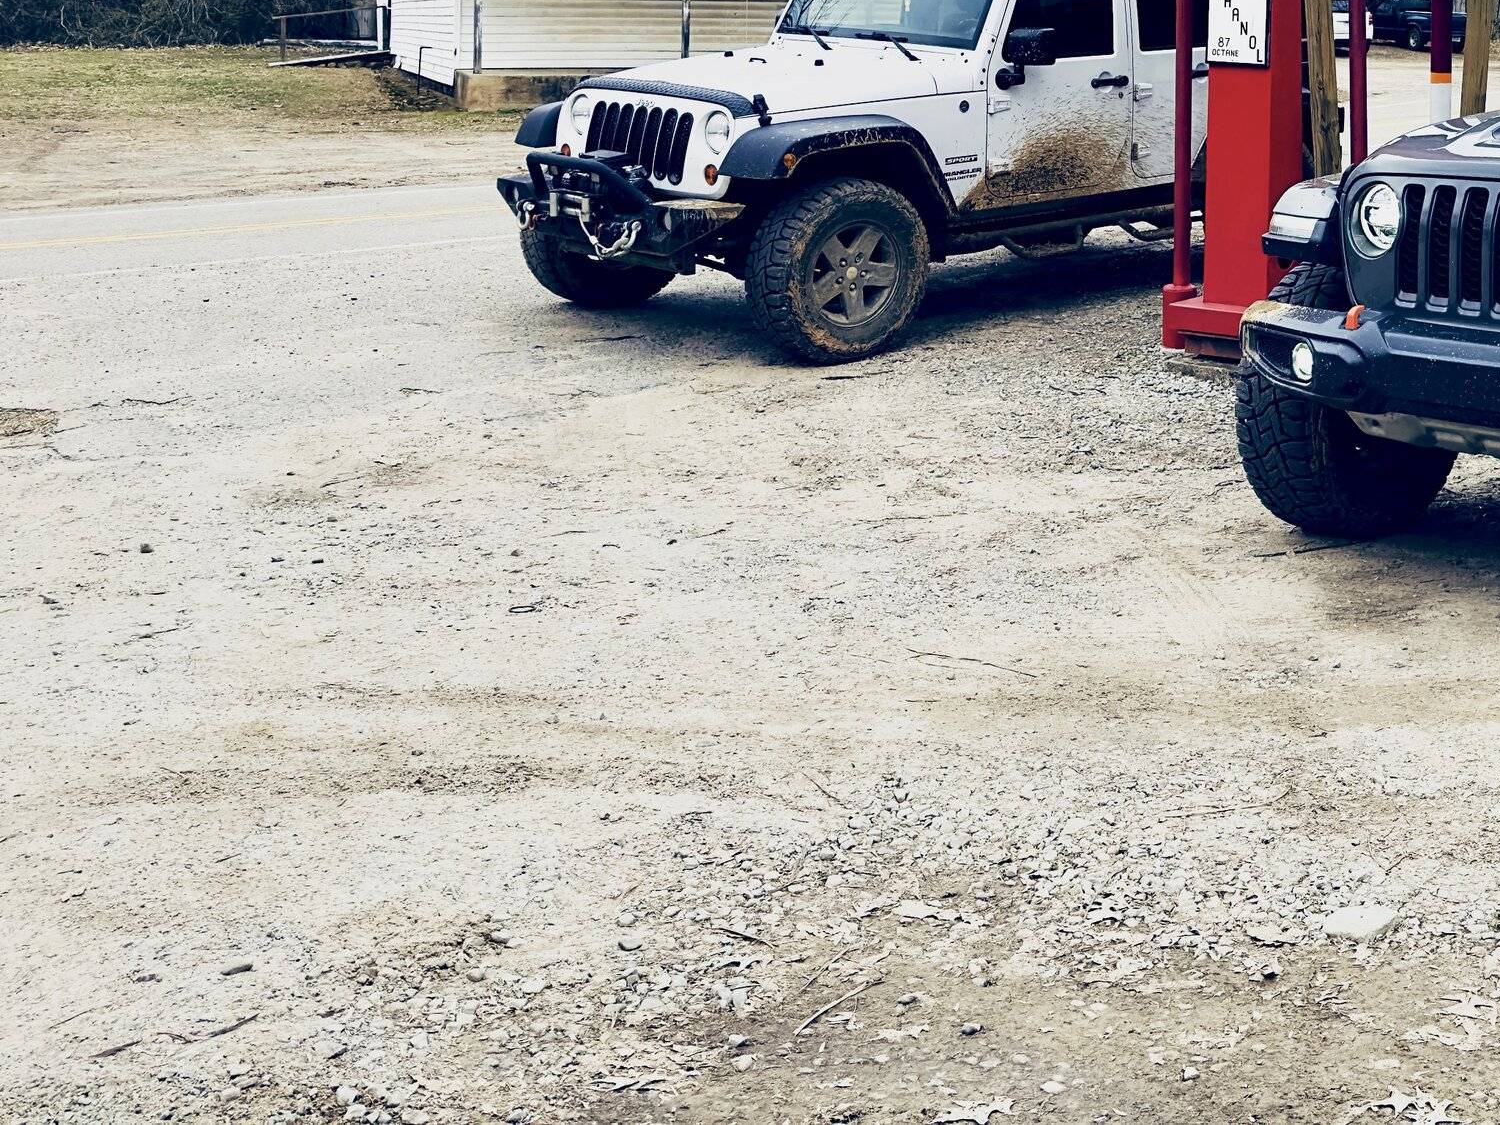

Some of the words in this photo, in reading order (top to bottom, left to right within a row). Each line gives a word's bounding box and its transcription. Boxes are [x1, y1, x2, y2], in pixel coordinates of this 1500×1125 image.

[1217, 36, 1231, 48] 87
[1212, 49, 1239, 57] OCTANE
[947, 156, 976, 164] SPORT
